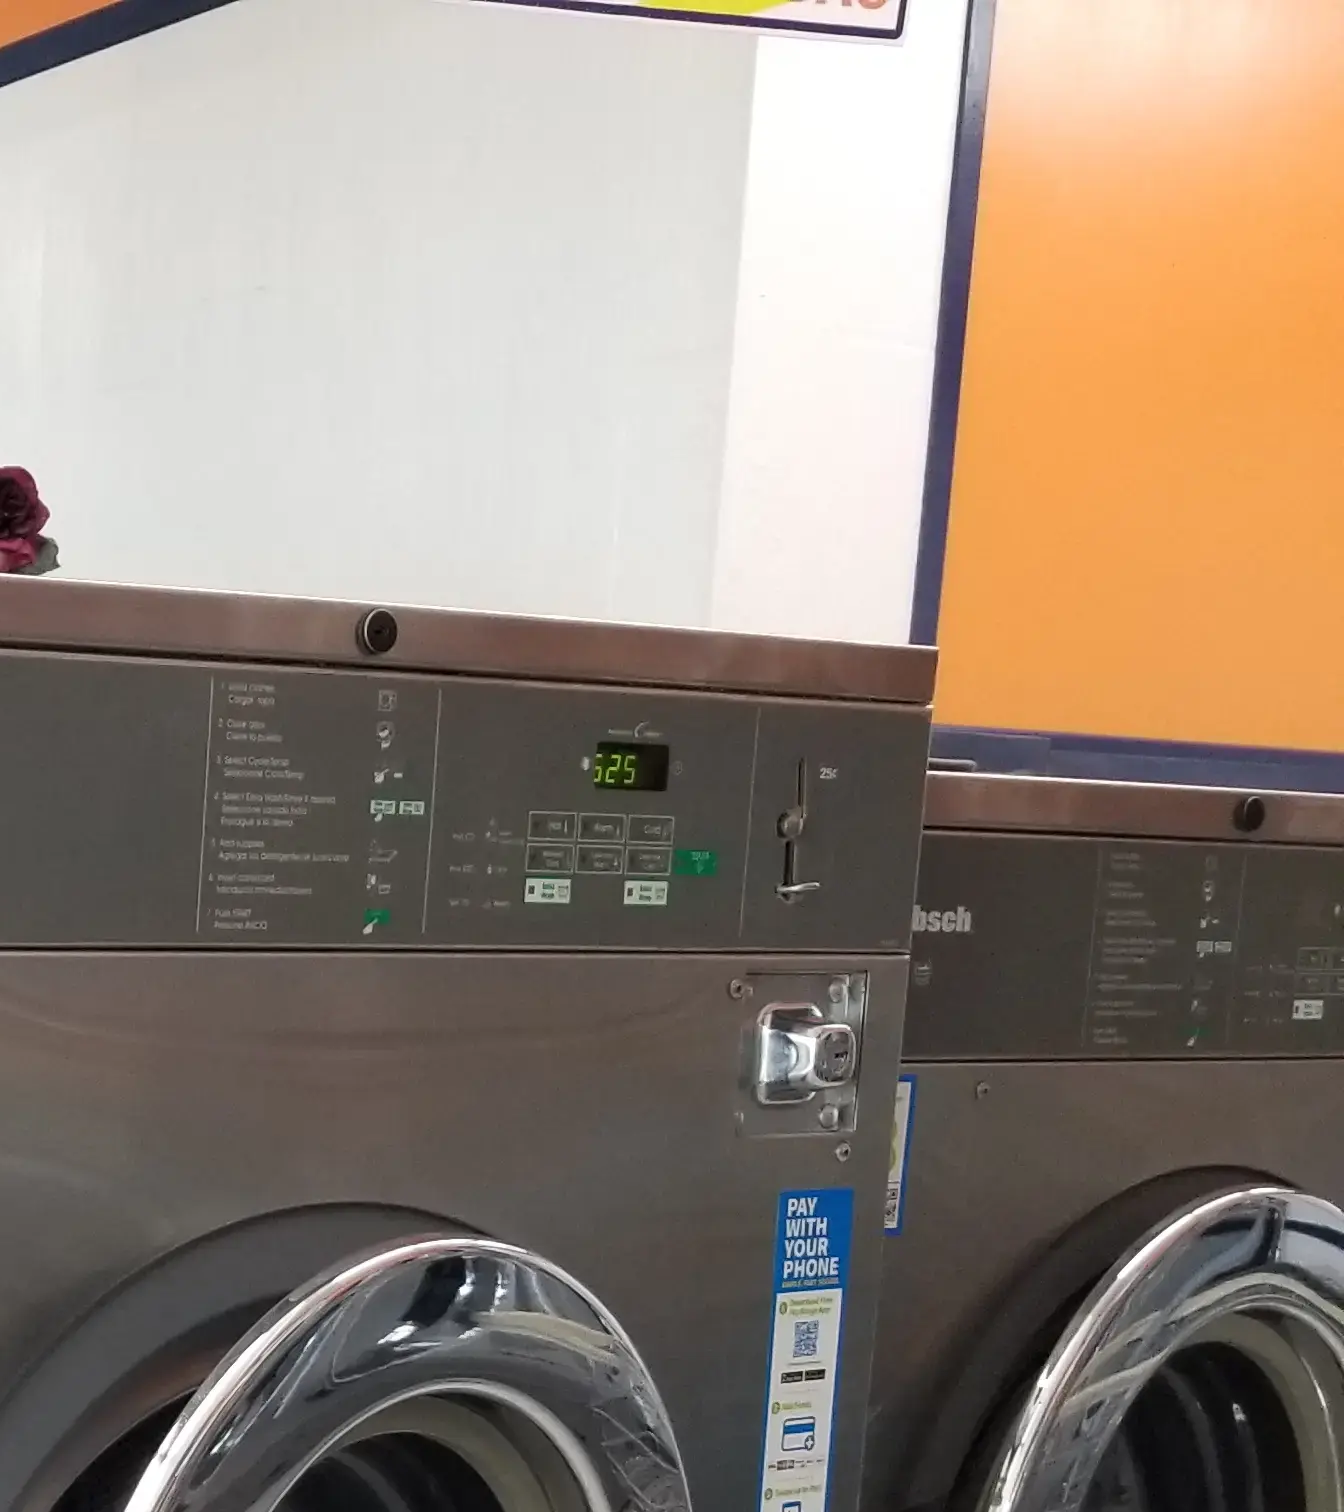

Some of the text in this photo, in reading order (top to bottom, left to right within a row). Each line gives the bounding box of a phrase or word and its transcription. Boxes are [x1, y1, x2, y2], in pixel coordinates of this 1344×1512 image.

[787, 1196, 818, 1217] PAY
[786, 1216, 827, 1238] WITH
[784, 1238, 829, 1259] YOUR
[782, 1257, 840, 1279] PHONE
